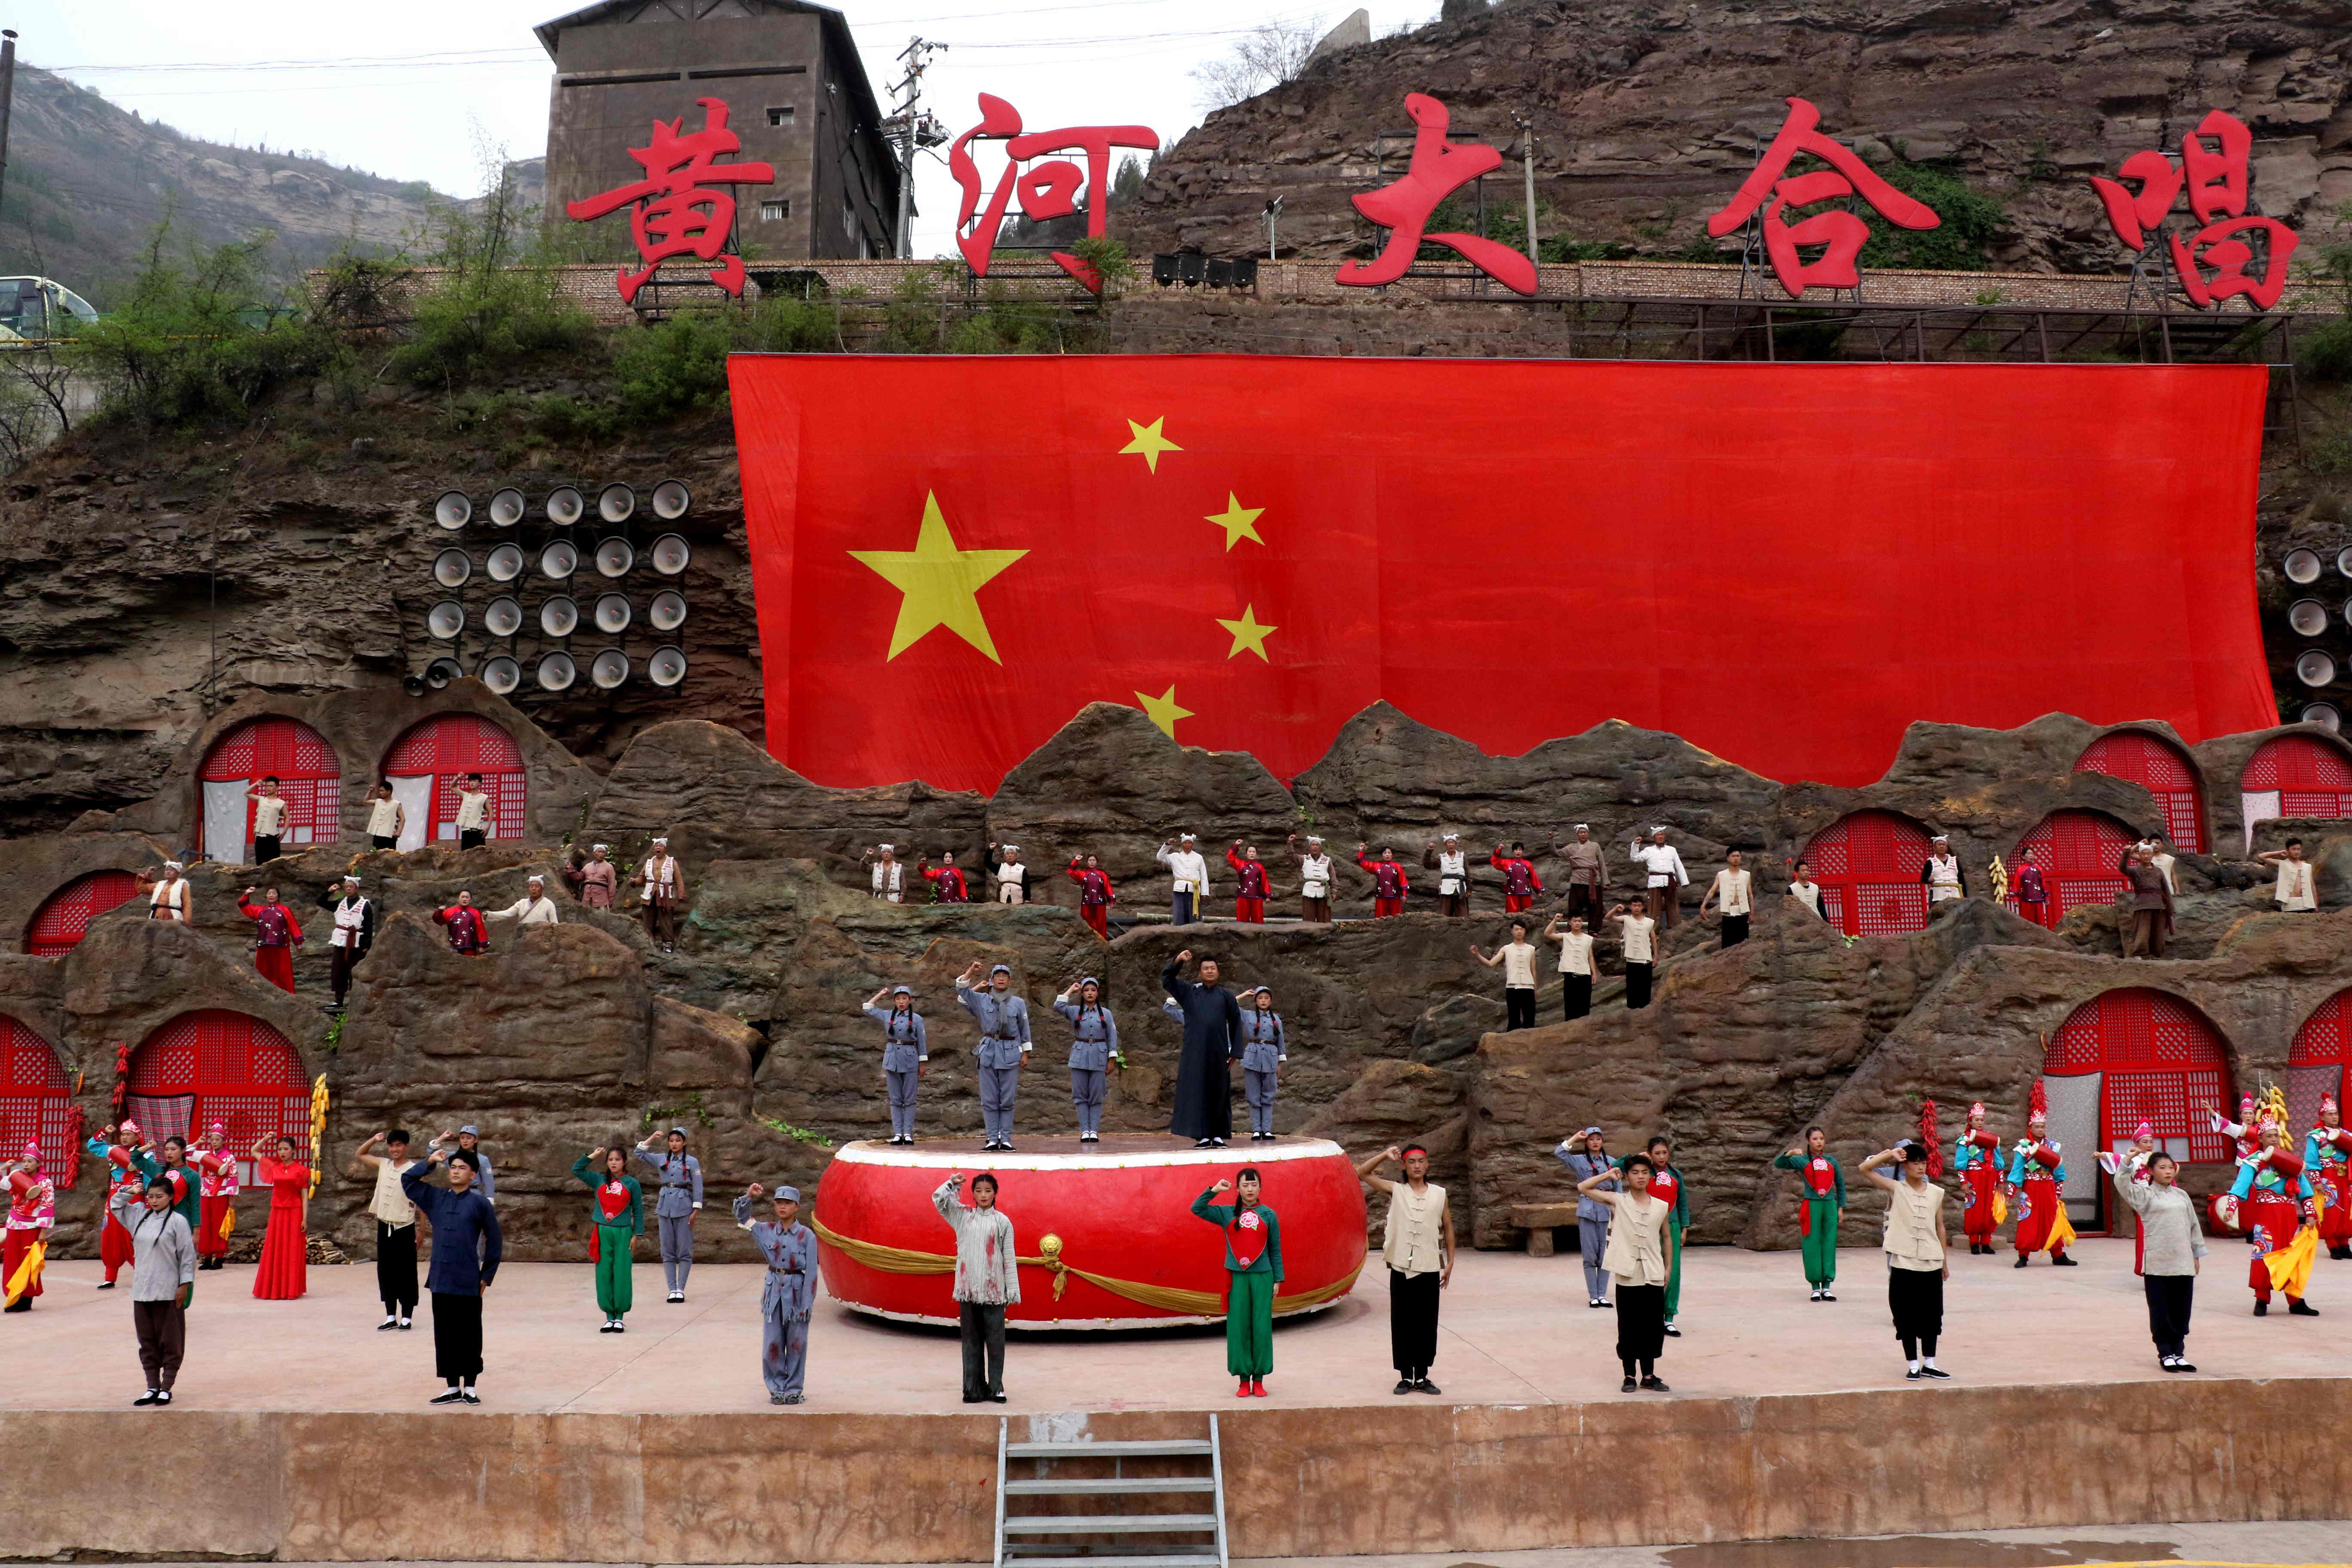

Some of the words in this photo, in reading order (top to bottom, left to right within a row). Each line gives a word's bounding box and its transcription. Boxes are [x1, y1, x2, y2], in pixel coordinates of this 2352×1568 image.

[567, 92, 2300, 309] 黄河大合唱
